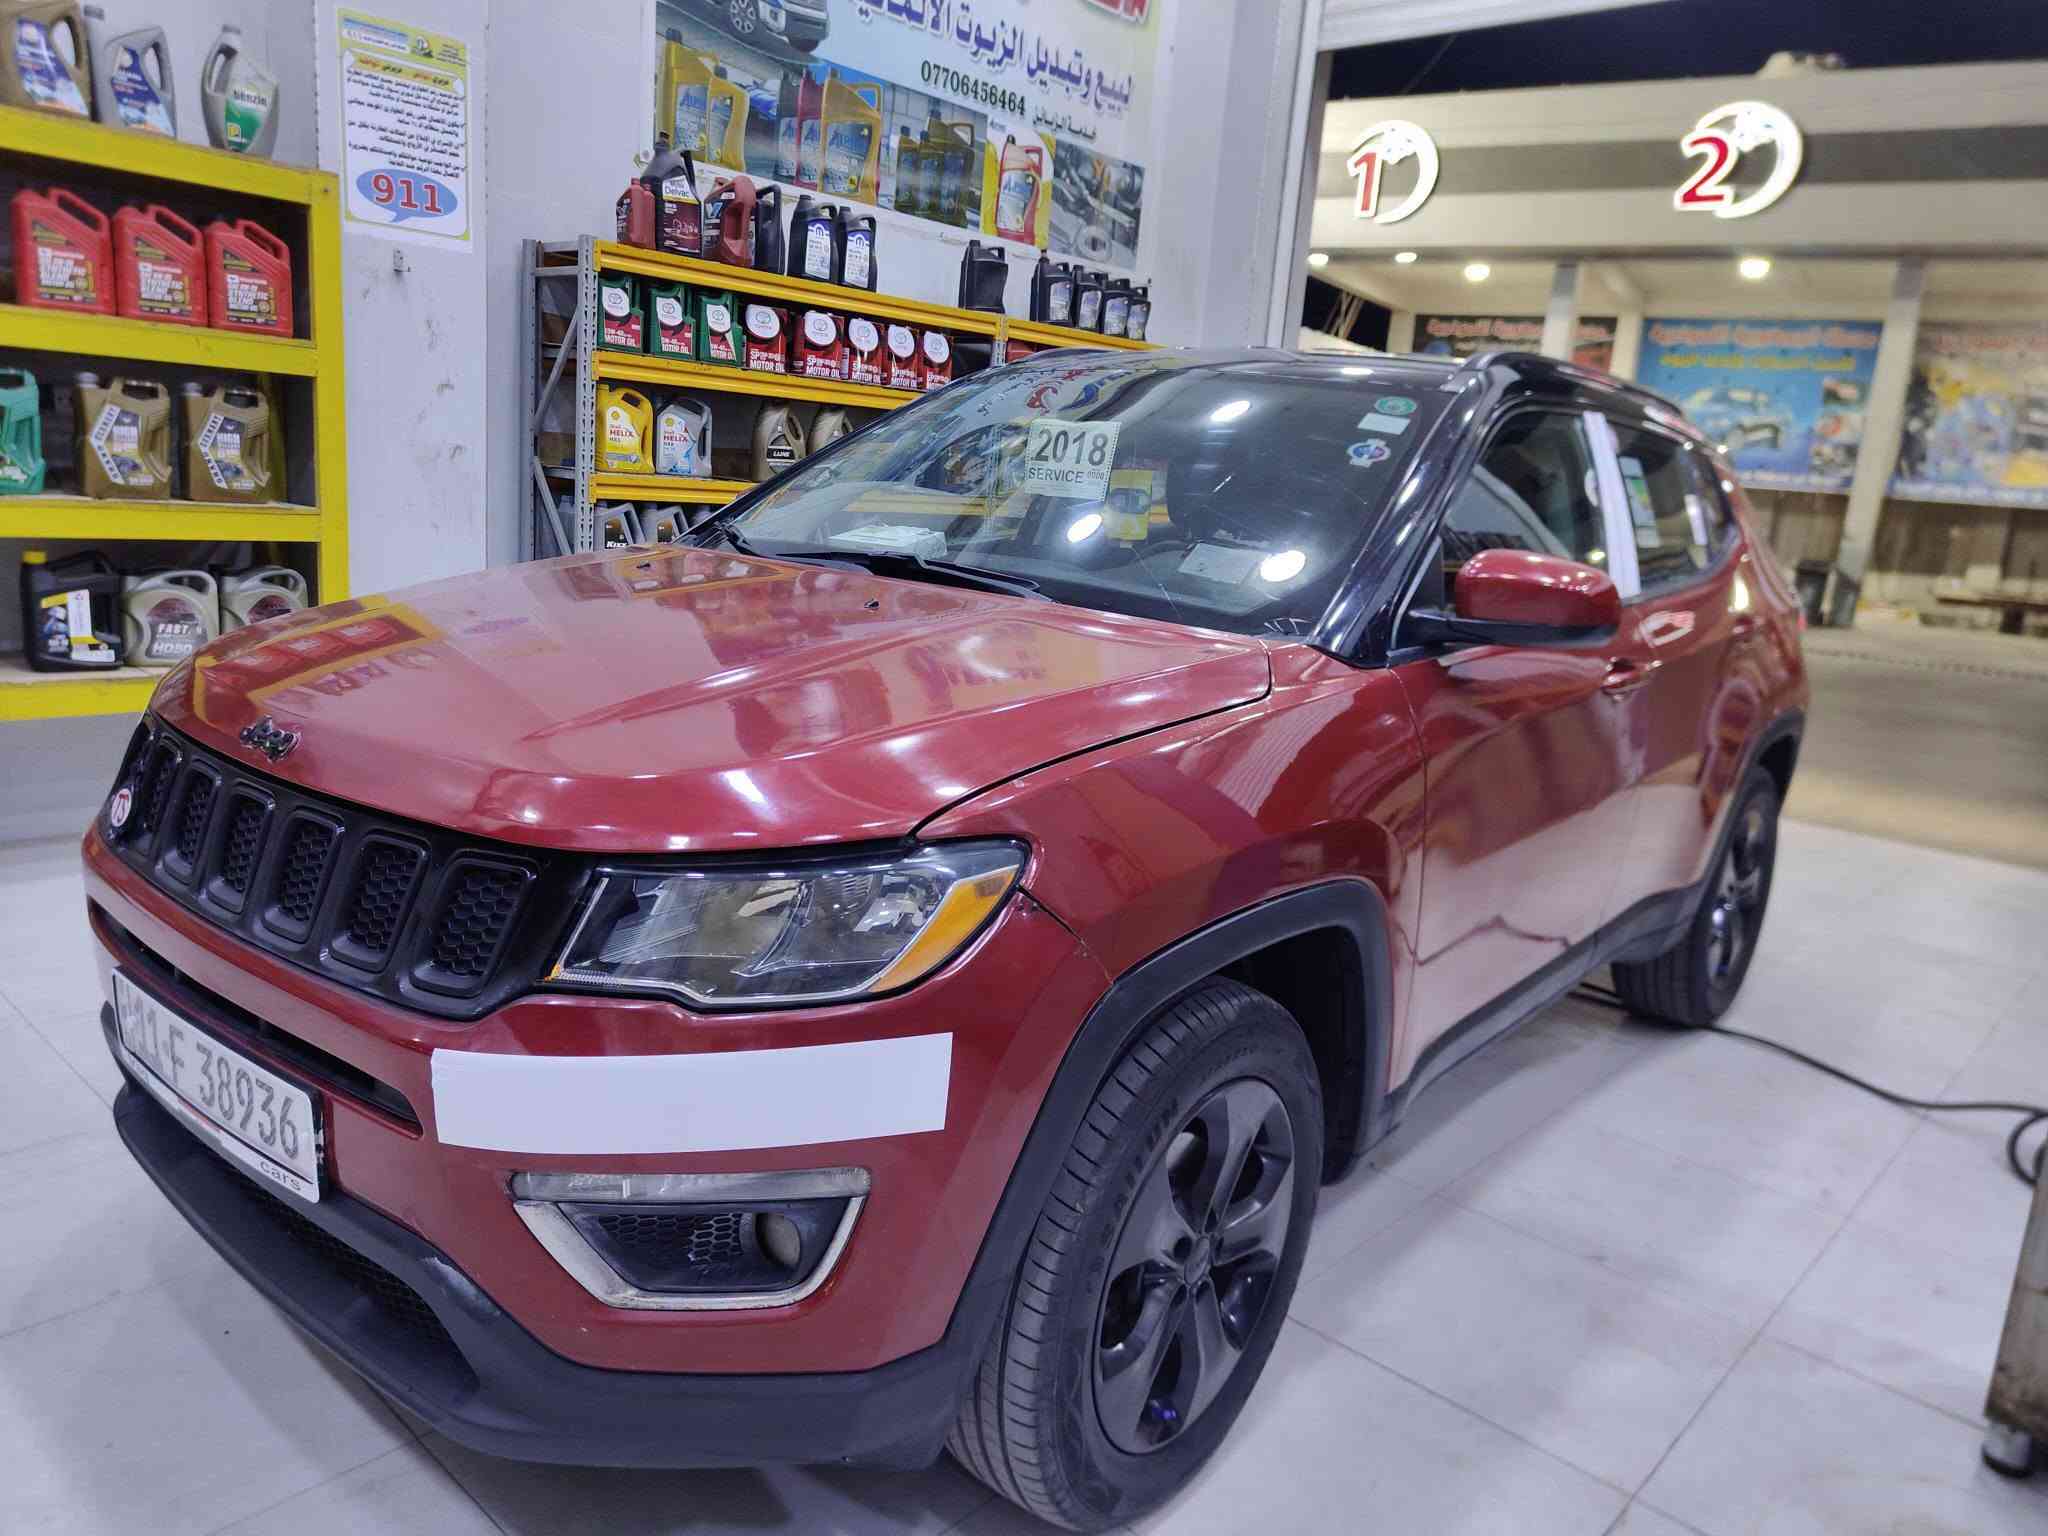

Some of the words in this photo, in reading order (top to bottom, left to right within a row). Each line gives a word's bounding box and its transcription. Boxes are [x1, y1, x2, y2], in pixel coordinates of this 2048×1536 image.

[956, 2, 1024, 67] الزيوت
[1026, 36, 1092, 99] وتبديل
[920, 61, 1026, 116] 07706456464
[1352, 151, 1379, 212] 1
[1677, 131, 1733, 207] 2
[373, 174, 442, 213] 911
[749, 359, 775, 371] MOTOR
[775, 362, 786, 373] OIL
[806, 366, 830, 377] MOTOR
[830, 368, 841, 378] OIL
[609, 429, 635, 438] HELIX
[663, 435, 689, 443] HELIX
[1030, 427, 1109, 467] 2018
[1028, 467, 1085, 484] SERVICE
[168, 1023, 185, 1089] F
[196, 1040, 299, 1161] 38936
[258, 1160, 302, 1192] cars
